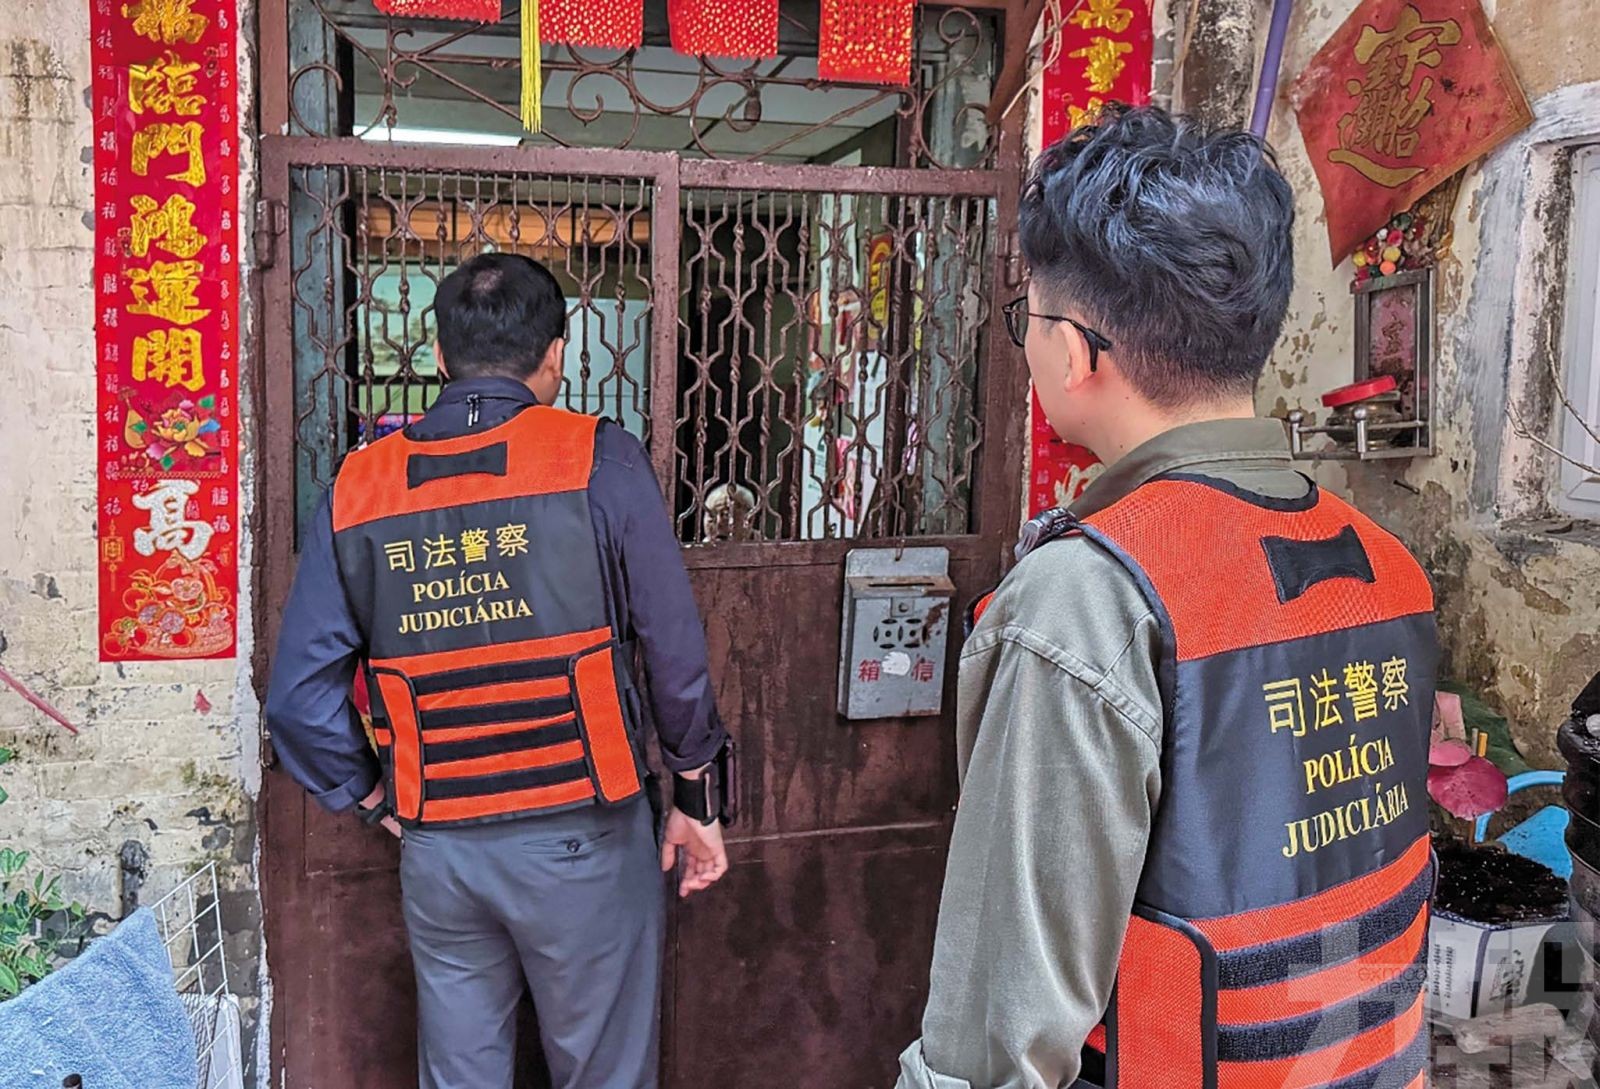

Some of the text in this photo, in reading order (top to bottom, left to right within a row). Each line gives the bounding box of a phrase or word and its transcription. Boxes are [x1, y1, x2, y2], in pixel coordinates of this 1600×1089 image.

[132, 478, 215, 562] 高
[384, 522, 529, 573] 司法警察
[398, 597, 534, 635] JUDICIÁRIA
[412, 570, 510, 604] POLÍCIA
[1262, 655, 1410, 738] 司法警察
[1303, 733, 1395, 795] POLÍCIA
[1282, 782, 1409, 858] JUDICIÁRIA
